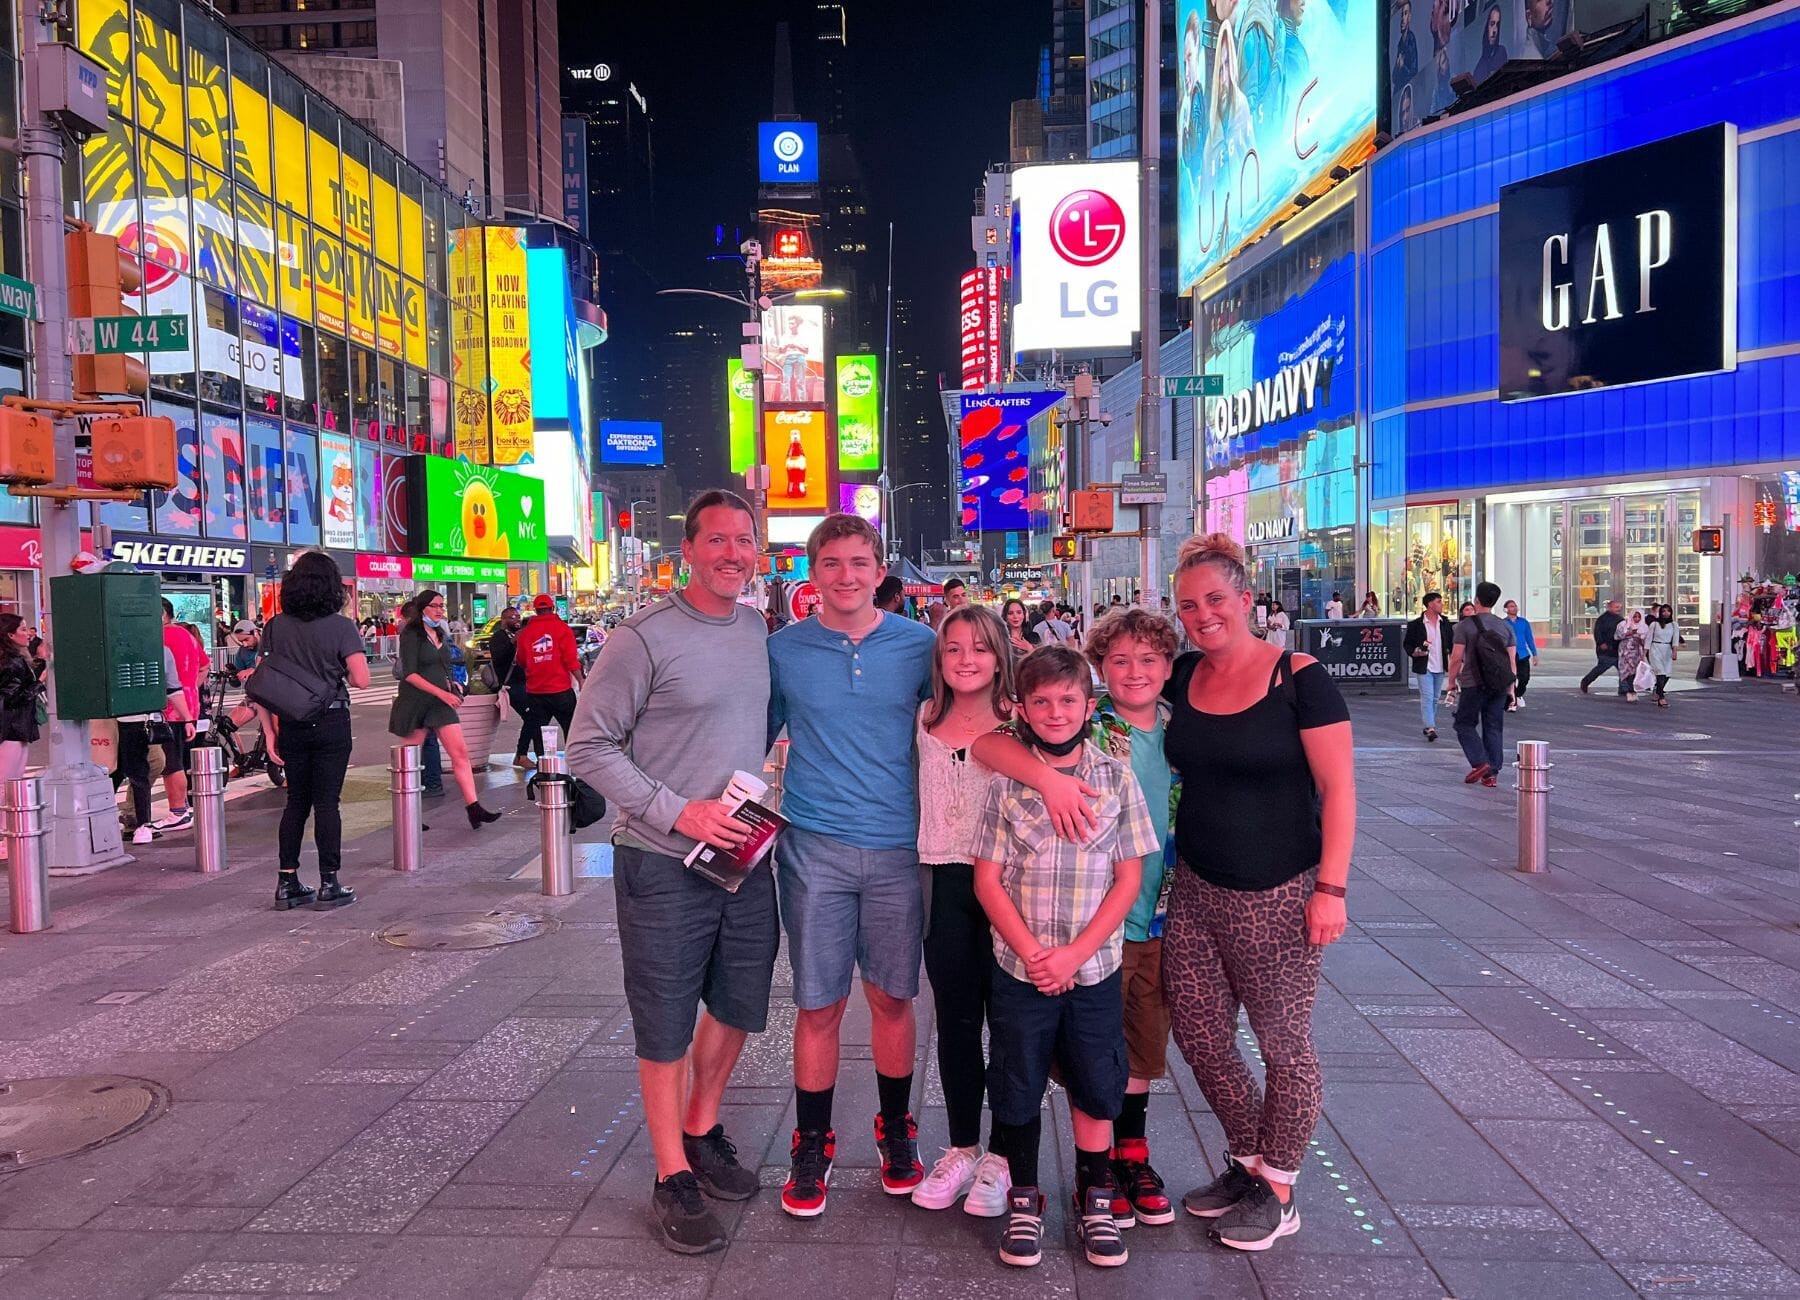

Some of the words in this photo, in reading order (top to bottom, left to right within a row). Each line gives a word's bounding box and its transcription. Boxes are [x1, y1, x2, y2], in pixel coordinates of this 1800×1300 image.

[778, 163, 800, 174] PLAN
[564, 132, 580, 230] TIMES
[328, 178, 370, 236] THE
[285, 199, 356, 298] LION
[359, 242, 419, 328] KING
[1542, 209, 1672, 332] GAP
[496, 274, 520, 292] NOW
[491, 293, 527, 309] PLAYING
[1059, 279, 1120, 319] LG
[503, 314, 515, 330] ON
[98, 322, 119, 349] W
[131, 320, 160, 348] 44
[170, 318, 185, 337] St
[491, 336, 527, 349] BROADWAY
[1166, 378, 1179, 396] W
[1184, 377, 1205, 395] 44
[1211, 377, 1221, 386] ST
[1214, 388, 1251, 441] OLD
[1255, 356, 1319, 428] NAVY
[496, 436, 511, 446] LION
[512, 436, 530, 447] KING
[607, 439, 657, 447] DAKTRONICS
[518, 521, 538, 540] NYC
[1248, 522, 1265, 541] OLD
[1265, 517, 1290, 539] NAVY
[1067, 539, 1075, 555] 9
[1713, 533, 1720, 548] 9
[111, 541, 246, 569] SKECHERS
[369, 561, 402, 573] COLLECTION
[417, 562, 434, 575] YORK
[441, 564, 453, 576] LINE
[453, 565, 475, 577] FRIENDS
[480, 567, 492, 577] NEW
[492, 567, 506, 577] YORK
[786, 557, 793, 570] 9
[1005, 568, 1041, 581] sunglas
[905, 585, 932, 594] TESTING
[1360, 627, 1384, 643] 25
[1322, 662, 1396, 677] HICAGO
[91, 738, 110, 747] CVS
